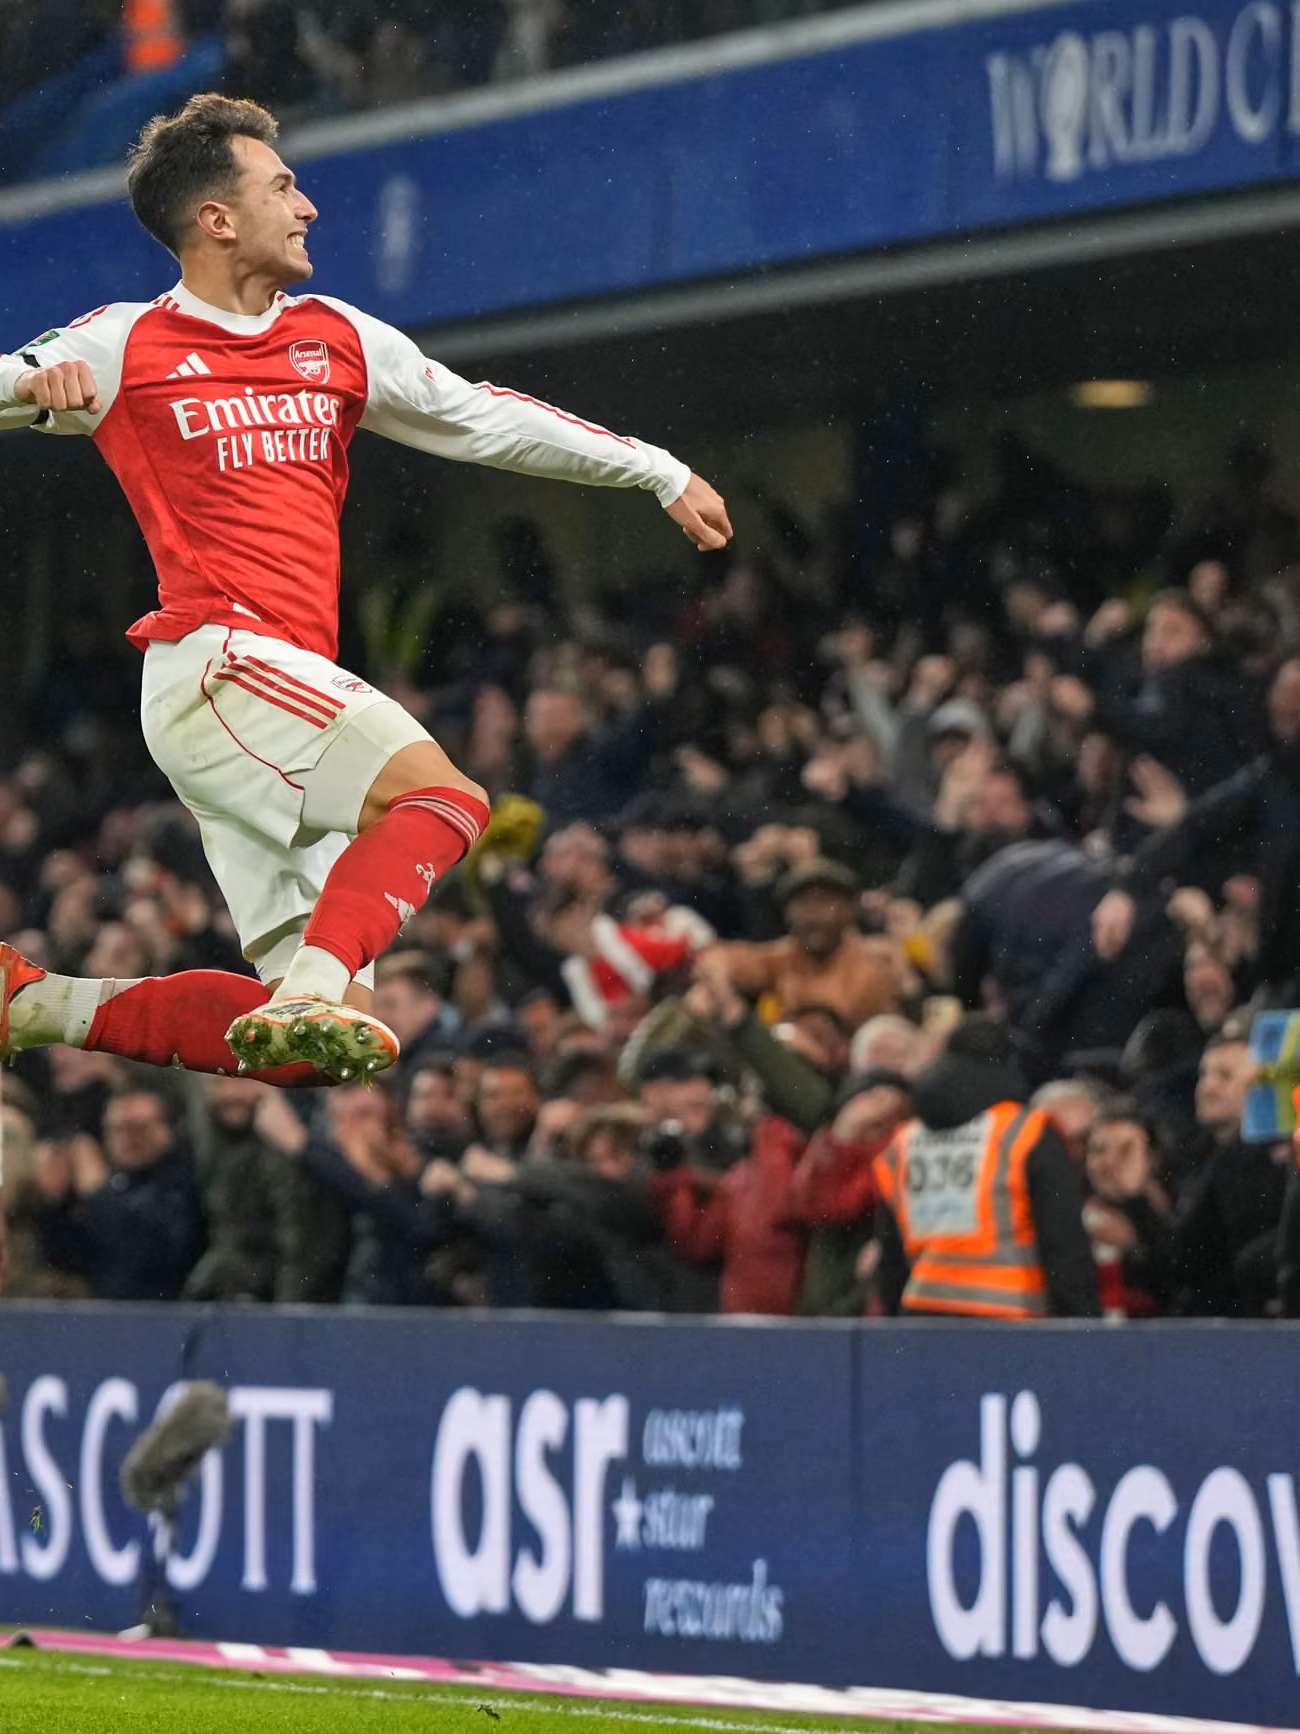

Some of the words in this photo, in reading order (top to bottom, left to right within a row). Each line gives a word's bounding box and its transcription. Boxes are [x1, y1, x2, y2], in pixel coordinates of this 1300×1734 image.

[169, 387, 340, 441] Emirates
[217, 433, 253, 471] FLY
[261, 427, 331, 463] BETTER
[430, 1386, 630, 1624] asr
